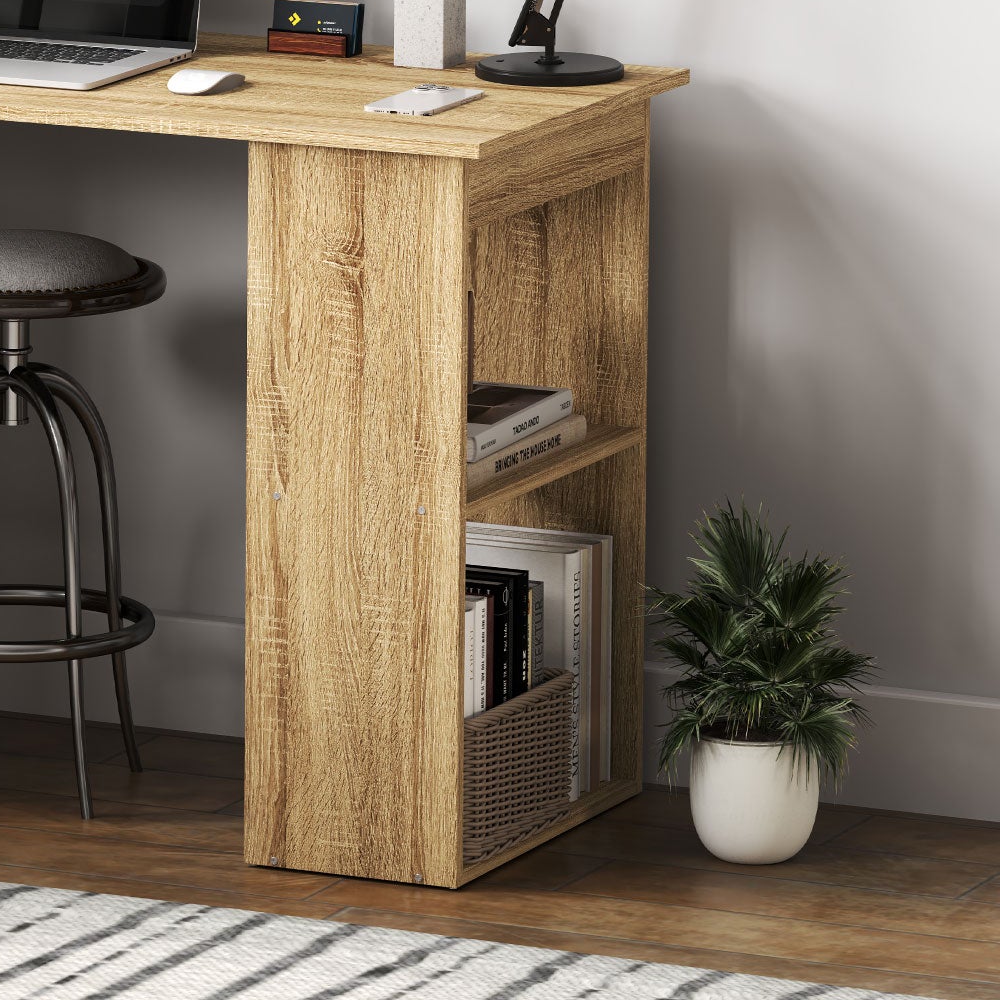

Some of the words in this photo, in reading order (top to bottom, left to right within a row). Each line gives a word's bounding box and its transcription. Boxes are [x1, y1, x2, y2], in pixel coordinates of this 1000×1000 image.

[513, 421, 527, 435] TADAO
[528, 416, 539, 429] ANDO
[495, 452, 519, 473] BRINGING
[520, 448, 530, 460] THE
[530, 441, 546, 457] HOUSE
[547, 434, 561, 449] HOME
[572, 655, 581, 714] STYLE
[572, 721, 580, 777] MEN'S
